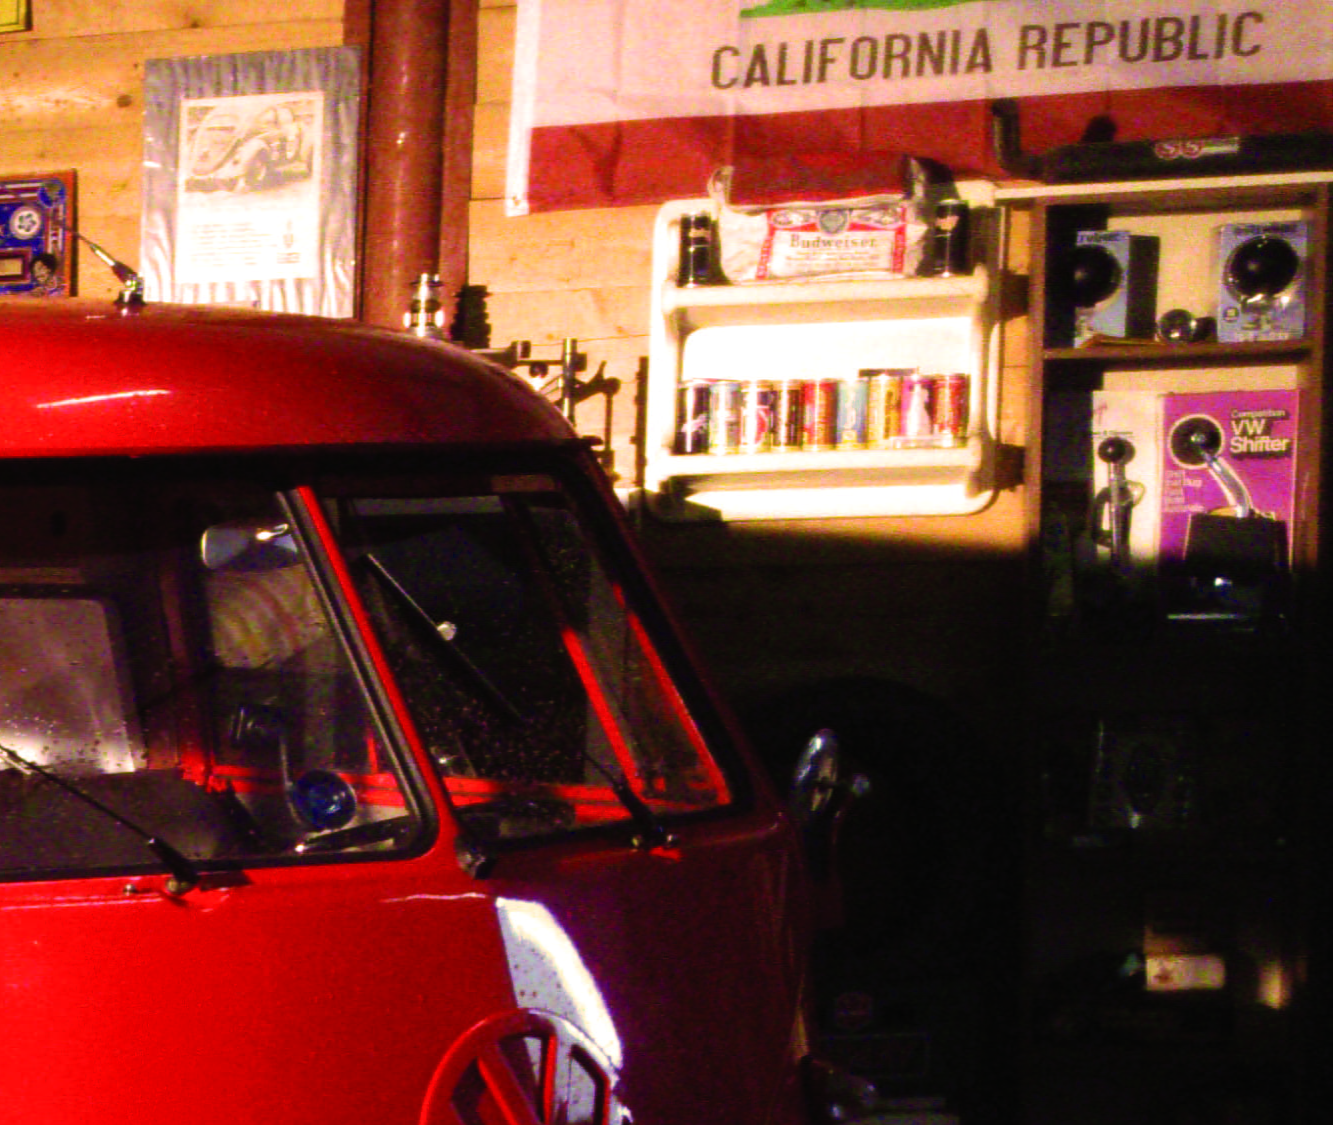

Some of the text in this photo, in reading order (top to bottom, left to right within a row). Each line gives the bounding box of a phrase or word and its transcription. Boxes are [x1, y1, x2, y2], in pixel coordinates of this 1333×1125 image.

[710, 11, 1265, 91] CALIFORNIA REPUBLIC
[789, 232, 877, 251] Budweiser
[1231, 408, 1286, 420] Competition
[1230, 418, 1267, 436] VW
[1229, 435, 1291, 454] Shifter
